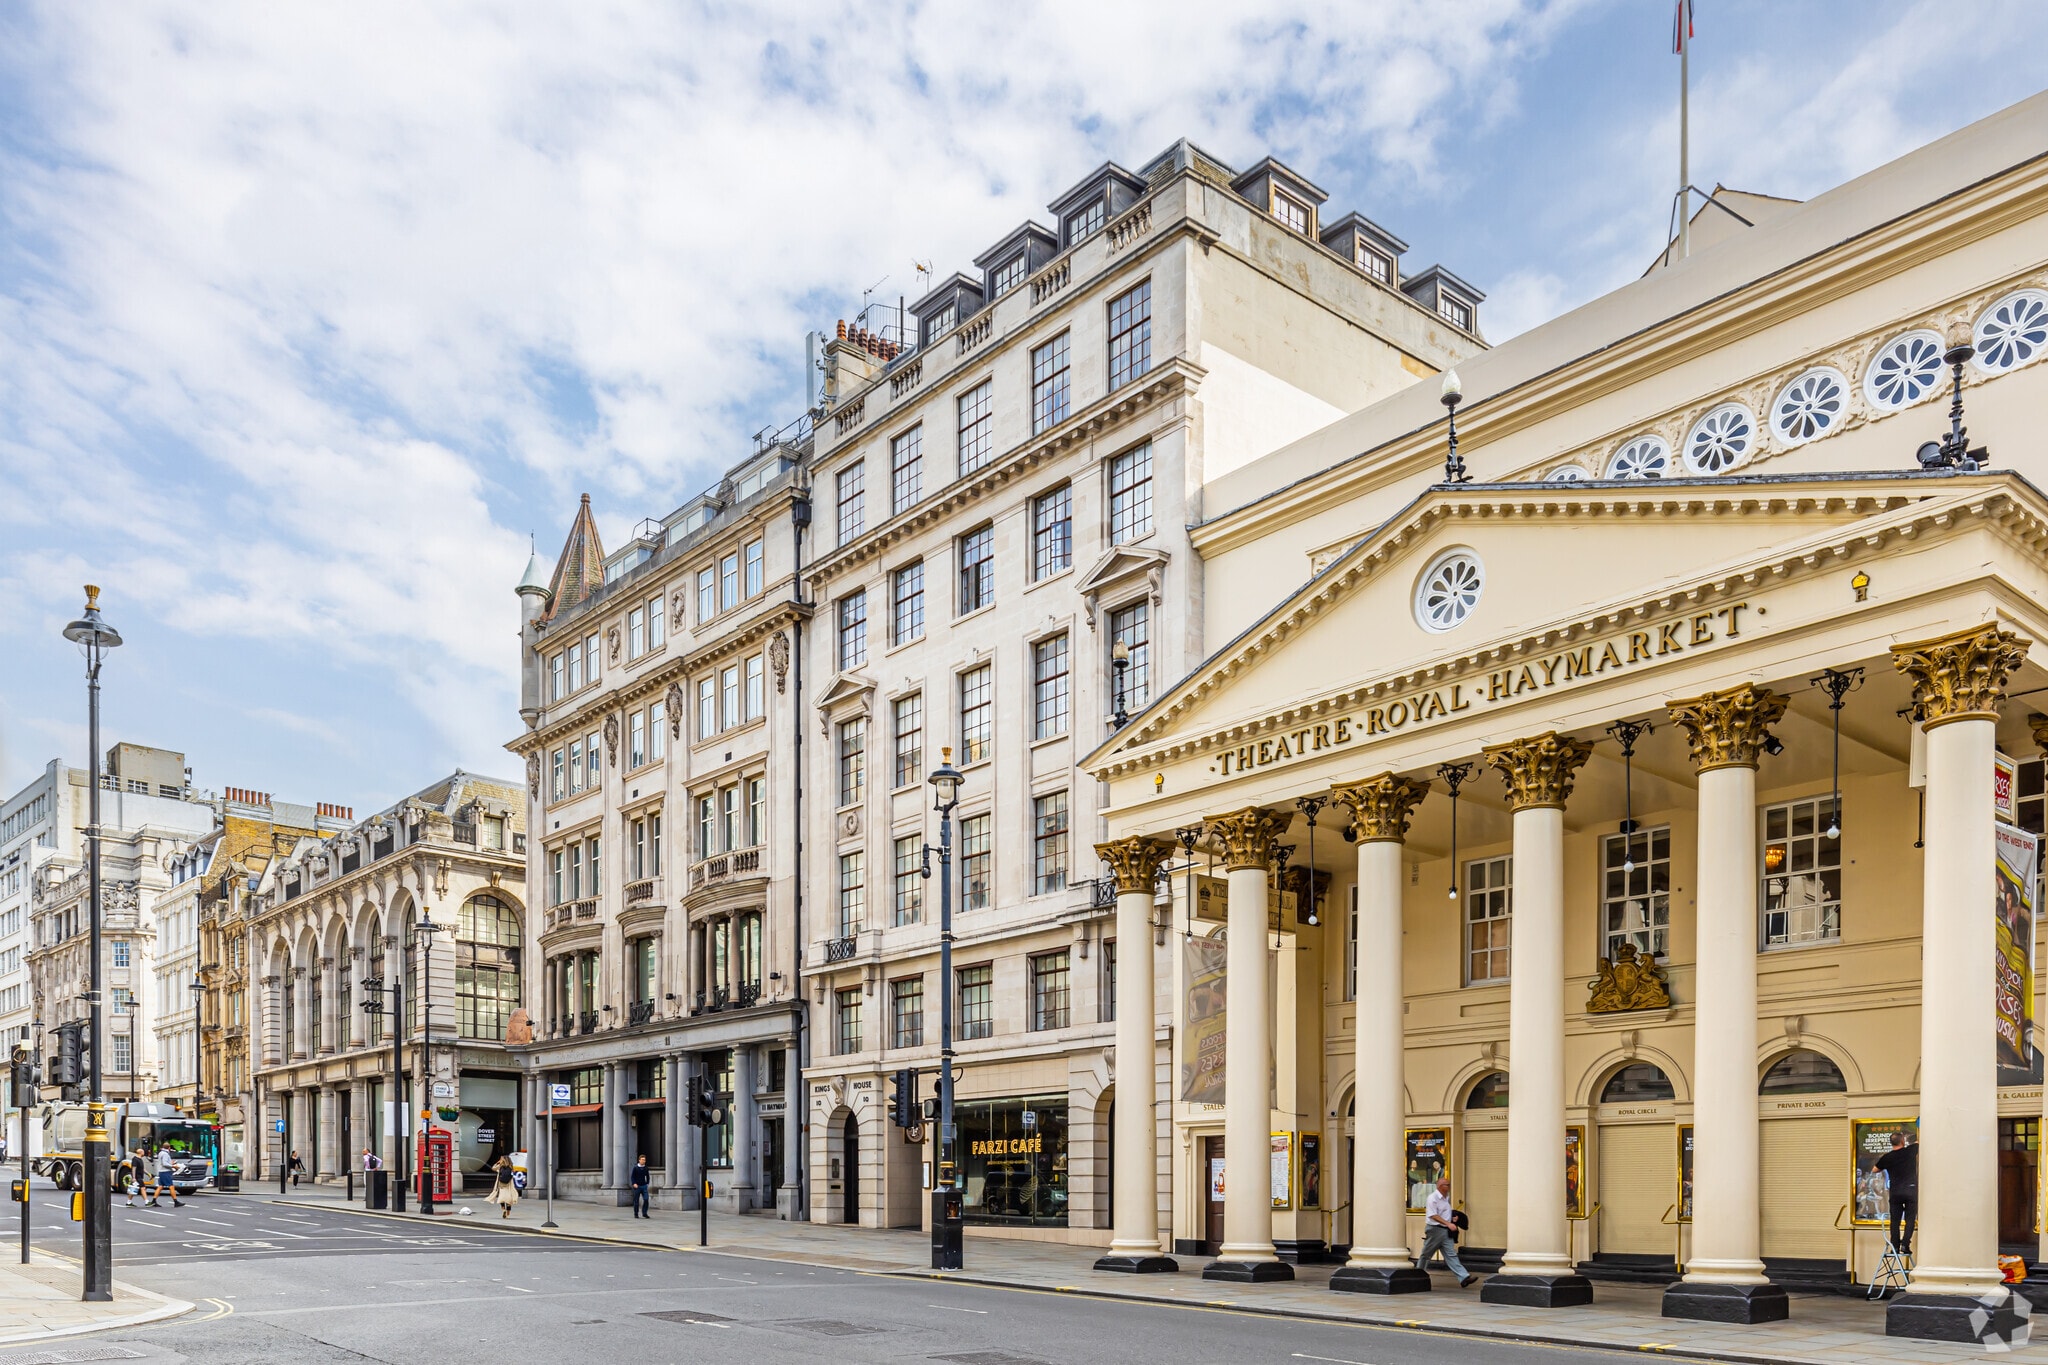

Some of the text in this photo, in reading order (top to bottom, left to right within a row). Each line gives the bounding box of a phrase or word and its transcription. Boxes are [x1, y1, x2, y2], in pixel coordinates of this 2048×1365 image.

[1215, 602, 1748, 775] THEATRE ROYAL HAYMARKET
[1996, 776, 2010, 797] RSES
[2011, 837, 2022, 848] WEST
[1996, 982, 2021, 1026] ORSES
[814, 1081, 872, 1093] KINGS HOUSE
[767, 1103, 785, 1111] HAYMA
[1203, 1103, 1225, 1111] STALLS
[972, 1133, 1042, 1155] FARZI CAFÉ
